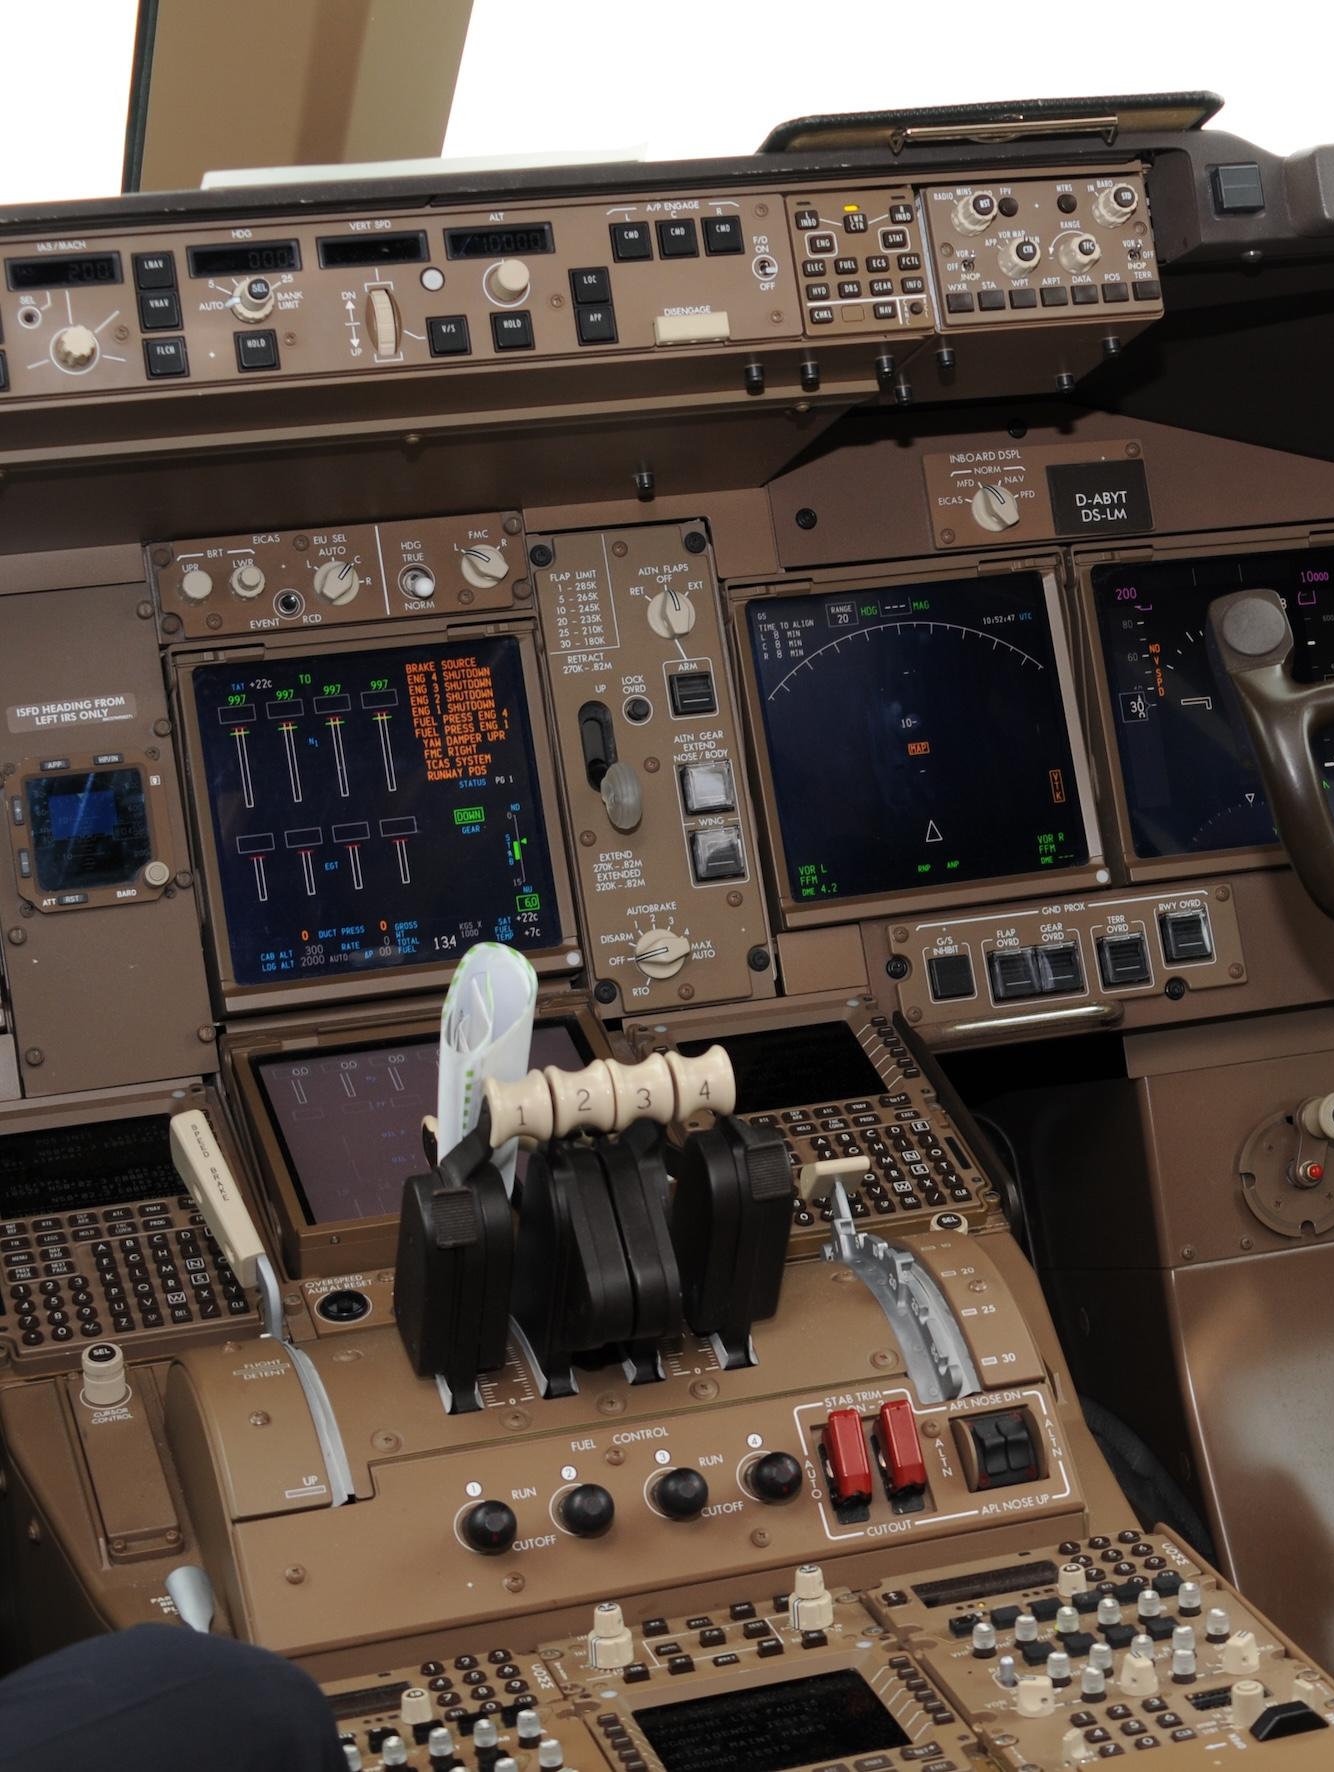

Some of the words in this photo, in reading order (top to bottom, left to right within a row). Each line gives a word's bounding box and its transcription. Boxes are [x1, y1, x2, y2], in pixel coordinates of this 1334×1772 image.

[934, 192, 953, 200] RADIO
[646, 202, 662, 211] A/P
[664, 201, 699, 210] ENGAGE
[489, 213, 504, 221] ALT
[350, 222, 371, 230] VERT
[375, 220, 391, 229] SPD
[716, 224, 731, 233] CMD
[232, 230, 252, 239] HDG
[624, 230, 639, 239] CMD
[671, 227, 685, 236] CMD
[889, 234, 903, 242] STAT
[37, 241, 86, 251] IAS/MACH
[840, 261, 855, 269] FUEL
[902, 257, 918, 265] FCTL
[807, 263, 823, 272] ELEC
[1042, 277, 1061, 285] ARPT
[1072, 275, 1092, 283] DATA
[1105, 273, 1120, 281] POS
[1012, 279, 1028, 287] WPT
[199, 301, 224, 311] AUTO
[664, 305, 711, 316] DISENGAGE
[950, 451, 995, 463] INBOARD
[998, 450, 1021, 460] DSPL
[974, 465, 1001, 474] NORM
[957, 479, 974, 488] MFD
[1004, 475, 1024, 484] NAV
[938, 496, 963, 505] EICAS
[1075, 491, 1127, 506] D-ABYT
[1081, 508, 1127, 522] DS-LM
[253, 534, 280, 545] EICAS
[313, 535, 328, 545] EIU
[332, 533, 348, 543] SEL
[468, 529, 488, 540] FMC
[401, 540, 421, 550] HDG
[207, 549, 223, 558] BRT
[319, 545, 346, 557] AUTO
[402, 552, 424, 562] TRUE
[639, 566, 659, 576] ALTN
[664, 563, 688, 573] FLAPS
[550, 572, 570, 581] FLAP
[576, 570, 596, 579] LIMIT
[656, 574, 672, 584] OFF
[576, 582, 597, 590] 285K
[688, 581, 703, 590] EXT
[630, 587, 644, 595] RET
[1116, 587, 1137, 600] 200
[577, 592, 598, 601] 265K
[405, 600, 435, 611] NORM
[557, 606, 566, 614] 10
[579, 604, 600, 613] 245K
[913, 601, 929, 610] MAG
[861, 607, 877, 615] HDG
[250, 618, 279, 629] EVENT
[302, 614, 322, 624] RCD
[557, 617, 567, 626] 20
[581, 615, 601, 624] 235K
[837, 615, 848, 624] 20
[559, 629, 569, 637] 25
[582, 626, 603, 635] 210K
[560, 639, 571, 648] 30
[584, 637, 606, 646] 180K
[568, 653, 604, 663] RETRACT
[406, 662, 435, 674] BRAKE
[442, 657, 477, 670] SOURCE
[678, 662, 697, 671] ARM
[407, 674, 426, 684] ENG
[432, 673, 437, 681] 4
[443, 667, 490, 680] SHUTDOWN
[622, 675, 644, 685] LOCK
[595, 685, 606, 693] UP
[623, 685, 646, 694] OVRD
[17, 706, 39, 717] ISFD
[42, 700, 92, 714] HEADING
[95, 697, 125, 707] FROM
[36, 715, 57, 725] LEFT
[61, 712, 76, 722] IRS
[80, 709, 108, 720] ONLY
[414, 716, 437, 726] FUEL
[443, 712, 473, 724] PRESS
[478, 709, 496, 720] ENG
[502, 708, 508, 717] 4
[423, 737, 441, 748] YAW
[446, 733, 481, 745] DAMPER
[488, 731, 506, 741] UPR
[674, 734, 694, 744] ALTN
[700, 730, 724, 740] GEAR
[424, 748, 442, 758] FMC
[448, 744, 477, 756] RIGHT
[683, 741, 716, 752] EXTEND
[426, 759, 450, 769] TCAS
[456, 754, 491, 767] SYSTEM
[427, 768, 462, 780] RUNWAY
[469, 766, 487, 775] POS
[459, 779, 486, 788] STATUS
[699, 817, 724, 826] WING
[600, 851, 632, 861] EXTEND
[597, 870, 641, 882] EXTENDED
[627, 902, 676, 916] AUTOBRAKE
[1042, 904, 1062, 915] GND
[1064, 902, 1085, 913] PROX
[1159, 901, 1177, 911] RWY
[1180, 899, 1201, 909] OVRD
[1040, 923, 1062, 933] GEAR
[601, 933, 634, 944] DISARM
[1042, 930, 1064, 941] OVRD
[692, 941, 712, 950] MAX
[692, 950, 715, 960] AUTO
[609, 957, 625, 966] OFF
[632, 986, 649, 996] RTO
[699, 1080, 710, 1100] 4
[576, 1089, 592, 1111] 2
[637, 1088, 651, 1109] 3
[517, 1106, 525, 1126] 1
[305, 1274, 363, 1289] OVERSPEED
[981, 1305, 996, 1314] 25
[1002, 1353, 1015, 1362] 30
[825, 1394, 852, 1407] STAB
[856, 1390, 881, 1403] TRIM
[950, 1399, 973, 1411] APL
[976, 1395, 1001, 1407] NOSE
[1004, 1391, 1021, 1402] DN
[571, 1439, 596, 1452] FUEL
[613, 1426, 669, 1445] CONTROL
[699, 1454, 723, 1467] RUN
[512, 1487, 537, 1500] RUN
[701, 1501, 744, 1518] CUTOFF
[982, 1503, 1001, 1516] APL
[1003, 1498, 1034, 1511] NOSE
[1036, 1494, 1049, 1505] UP
[867, 1520, 912, 1536] CUTOUT
[512, 1534, 556, 1552] CUTOFF
